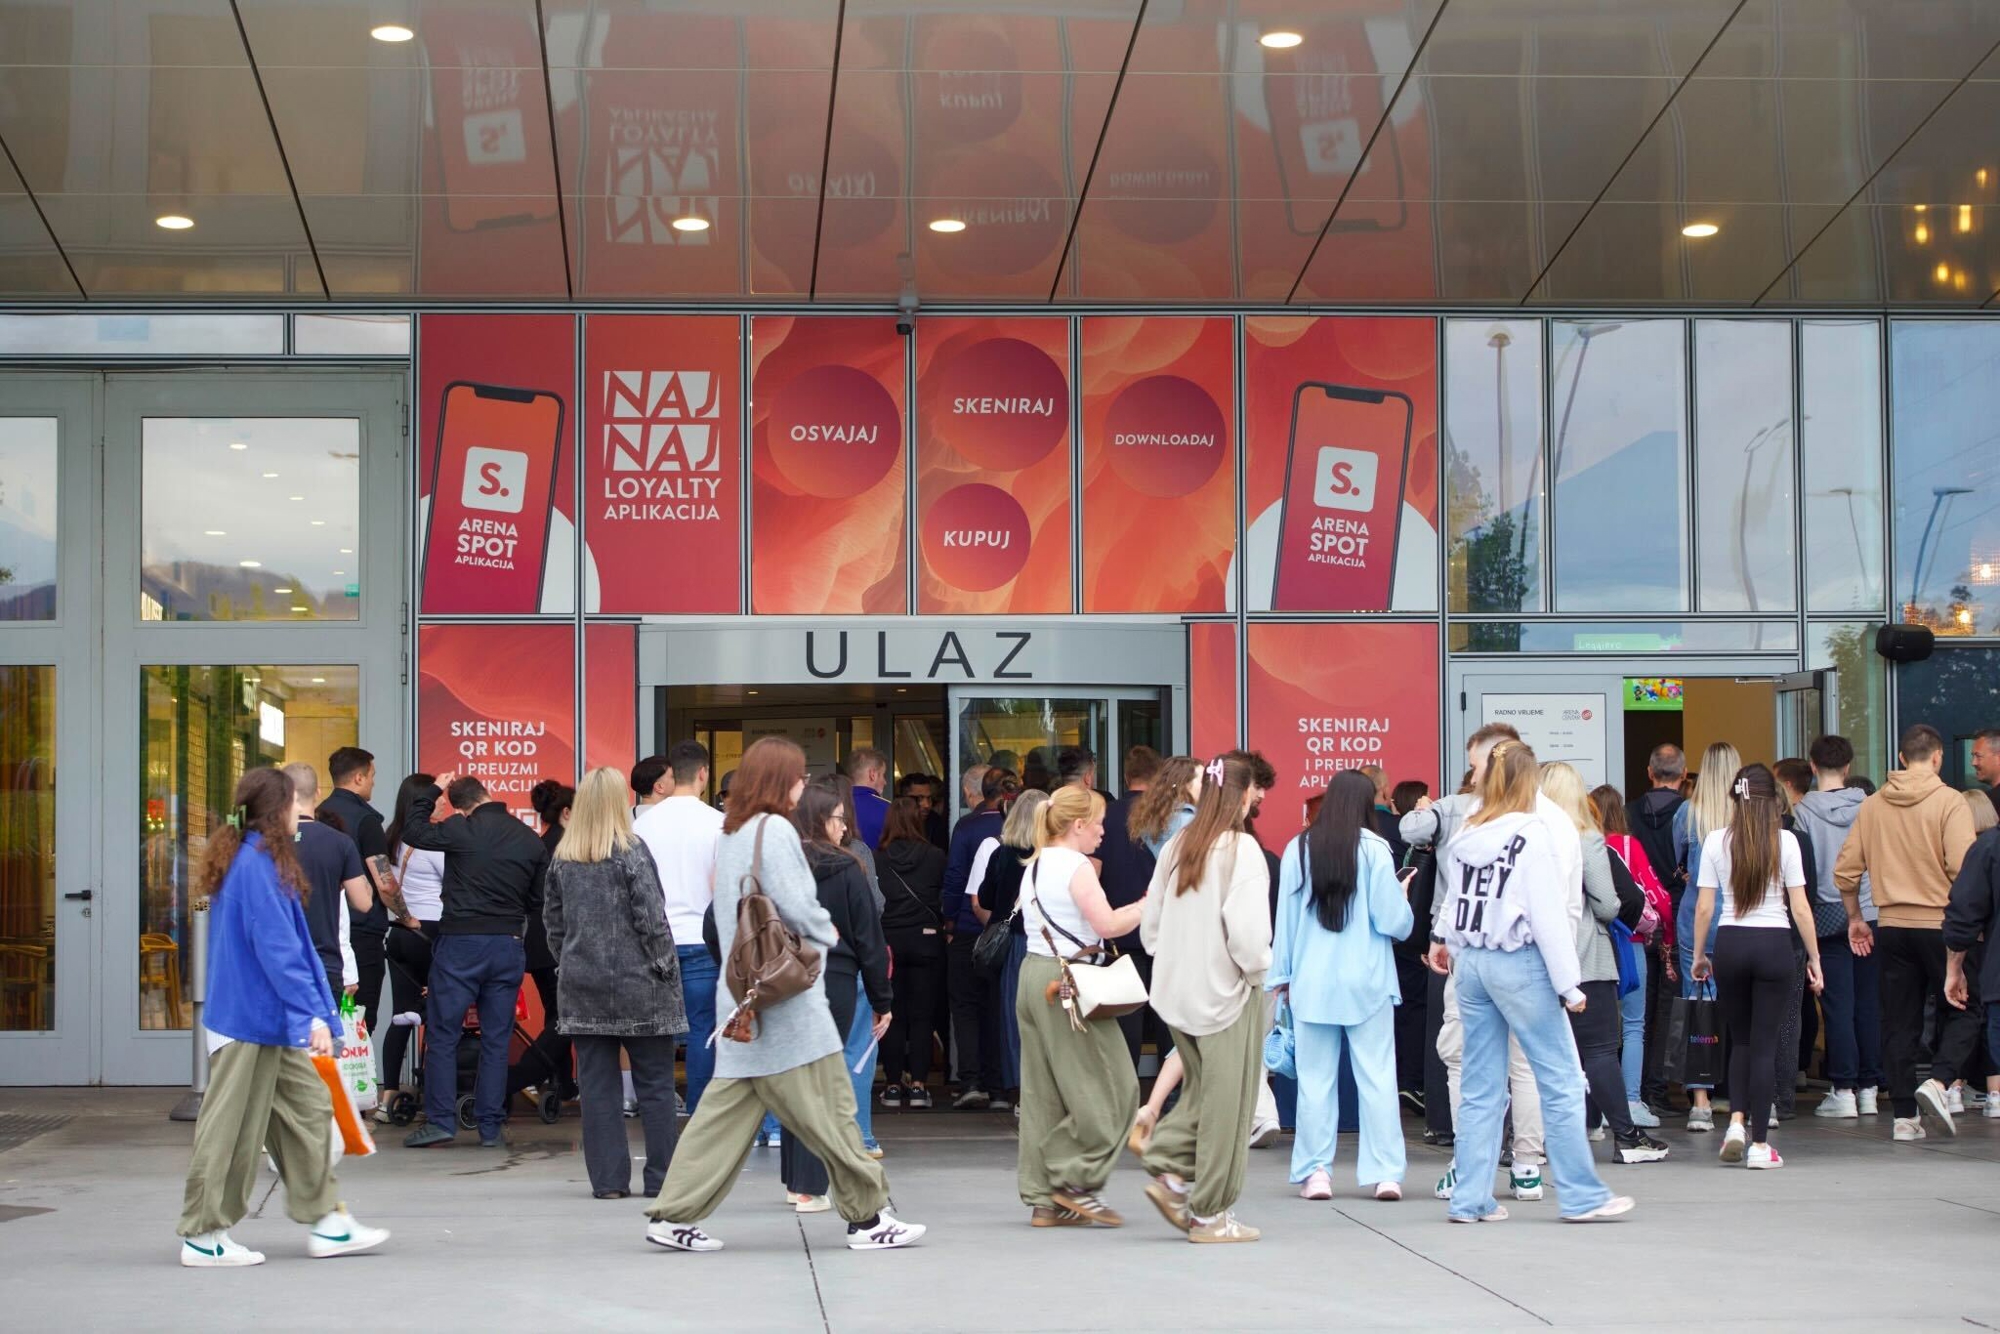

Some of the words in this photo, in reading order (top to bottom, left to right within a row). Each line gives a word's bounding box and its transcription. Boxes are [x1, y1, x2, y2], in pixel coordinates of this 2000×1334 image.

[604, 371, 720, 418] NAJ
[953, 397, 1054, 417] SKENIRAJ
[790, 425, 878, 444] OSVAJAJ
[1114, 433, 1215, 447] DOWNLOADAJ
[604, 425, 720, 471] NAJ
[478, 462, 510, 497] S.
[1330, 461, 1361, 496] S.
[604, 478, 721, 499] LOYALTY
[604, 504, 720, 521] APLIKACIJA
[459, 517, 518, 538] ARENA
[1311, 516, 1370, 536] ARENA
[457, 534, 518, 558] SPOT
[943, 530, 1010, 549] KUPUJ
[1310, 532, 1369, 556] SPOT
[455, 555, 515, 570] APLIKACIJA
[1307, 553, 1366, 568] APLIKACIJA
[806, 631, 1032, 679] ULAZ
[451, 721, 545, 737] SKENIRAJ
[1298, 718, 1390, 733] SKENIRAJ
[459, 741, 488, 759] QR
[495, 741, 537, 756] KOD
[1306, 737, 1334, 755] QR
[1340, 737, 1382, 752] KOD
[458, 763, 462, 776] I
[468, 763, 538, 776] PREUZMI
[1305, 758, 1309, 771] I
